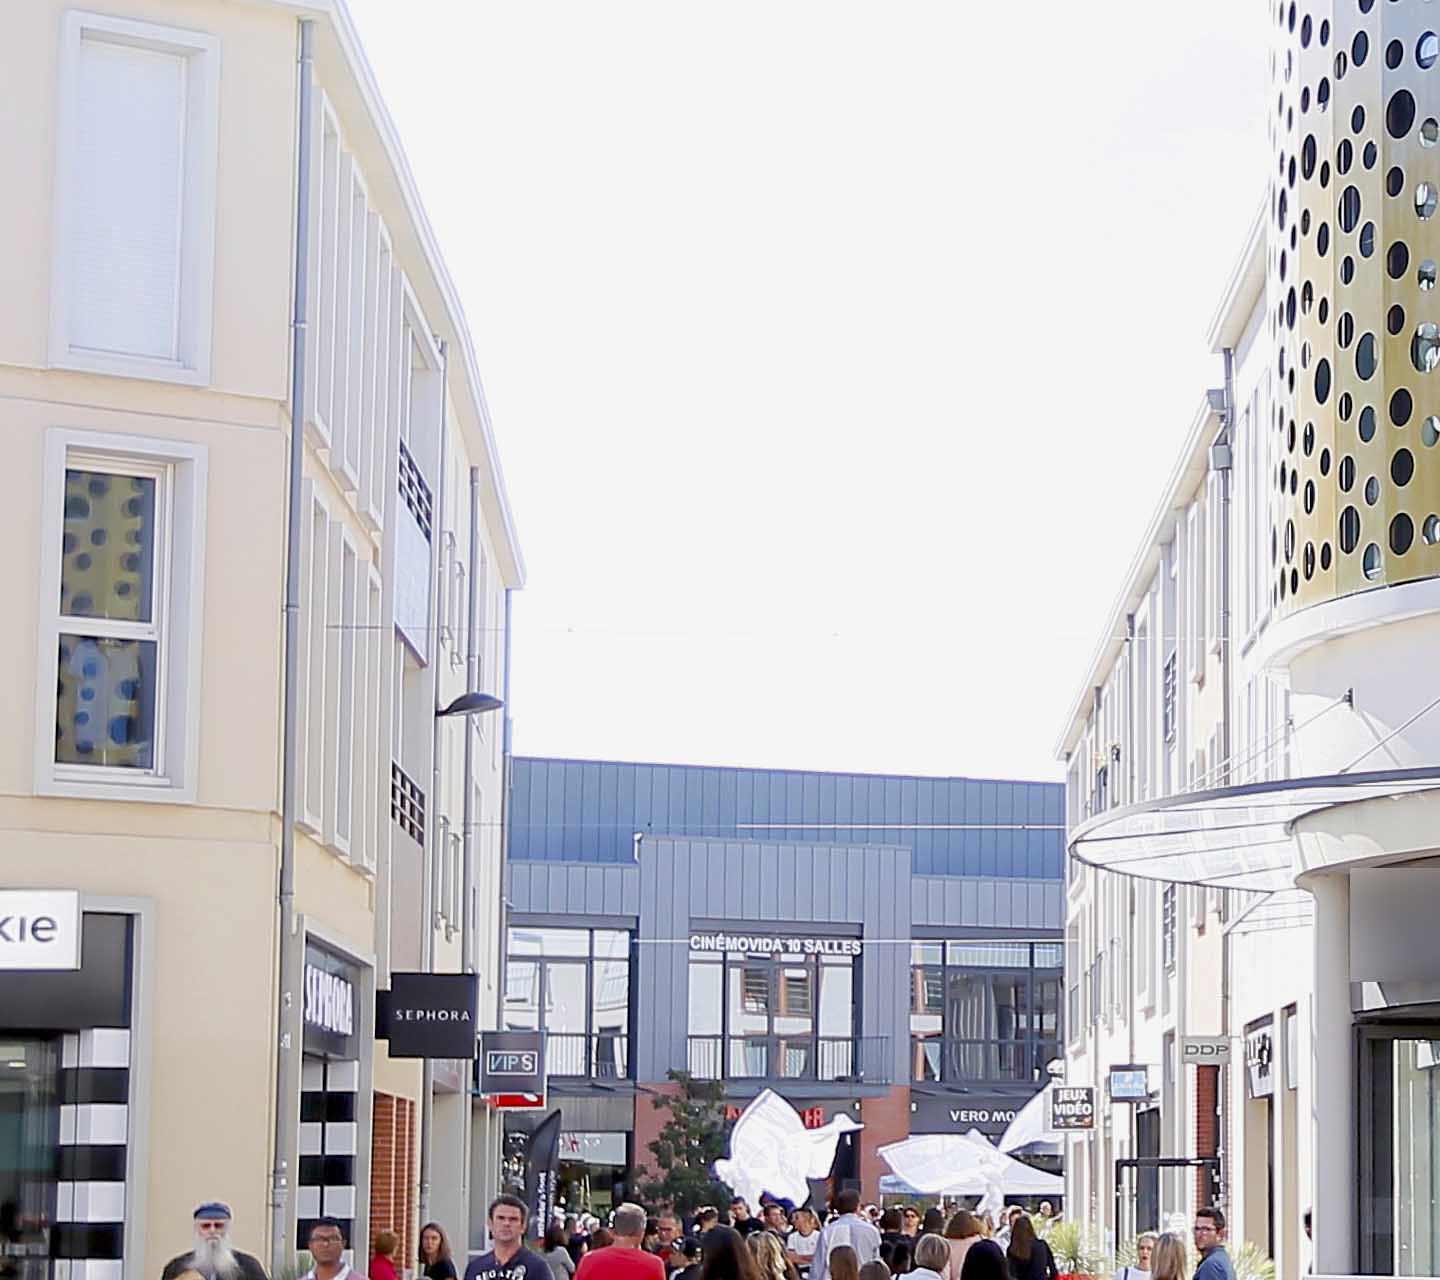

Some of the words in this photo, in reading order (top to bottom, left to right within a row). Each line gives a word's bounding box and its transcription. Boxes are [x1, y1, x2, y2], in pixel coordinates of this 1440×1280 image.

[690, 933, 783, 952] CINÉMOVIDA
[785, 941, 800, 953] 10
[804, 940, 862, 955] SALLES
[395, 1009, 470, 1021] SEPHORA
[1184, 1044, 1229, 1056] DDP
[1058, 1089, 1088, 1103] JEUX
[1054, 1100, 1092, 1116] VIDÉO
[950, 1111, 989, 1122] VERO
